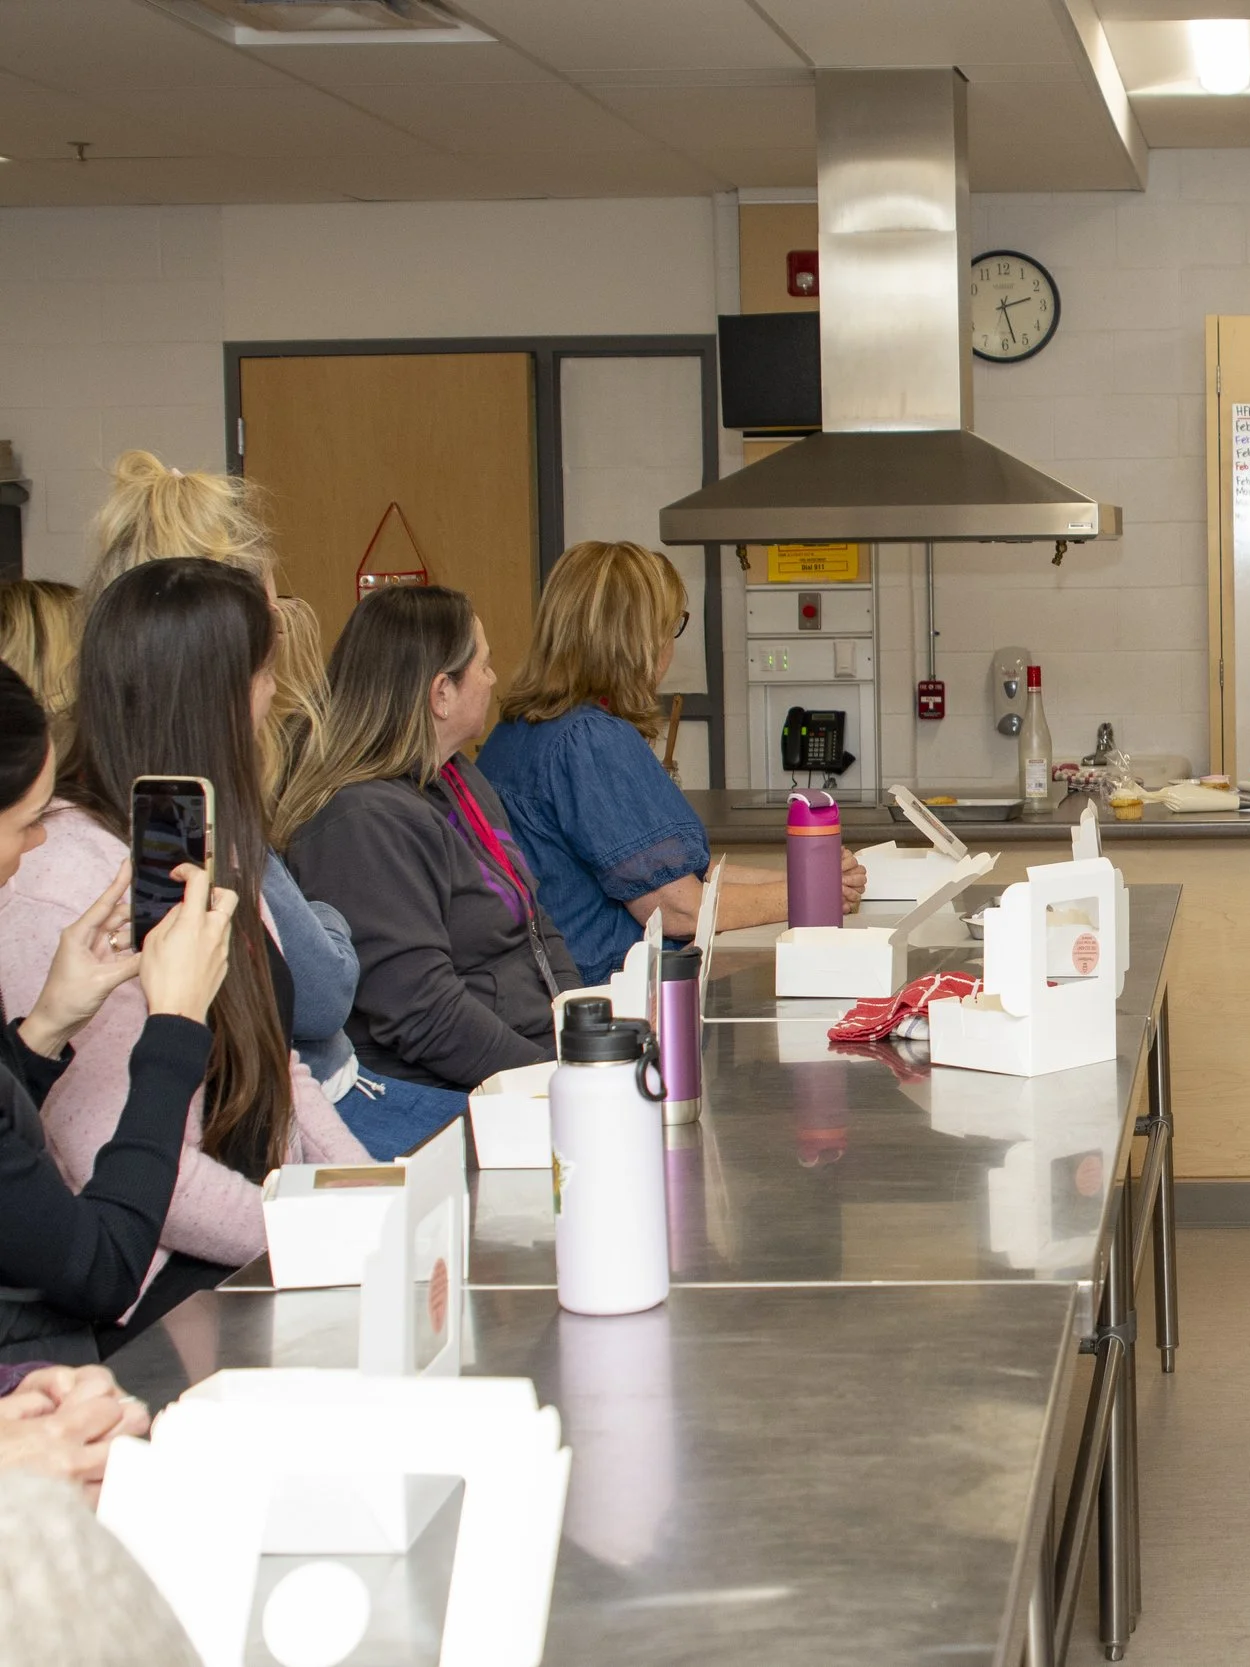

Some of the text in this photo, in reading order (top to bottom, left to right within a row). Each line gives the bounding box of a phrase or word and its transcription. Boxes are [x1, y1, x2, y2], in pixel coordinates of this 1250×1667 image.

[980, 268, 990, 281] 11
[997, 262, 1010, 275] 12
[1020, 268, 1025, 280] 1
[1033, 280, 1040, 292] 2
[1040, 299, 1047, 312] 3
[1034, 319, 1040, 331] 4
[982, 334, 988, 347] 7
[1001, 338, 1009, 351] 6
[1021, 333, 1029, 346] 5
[1235, 461, 1248, 471] Feb
